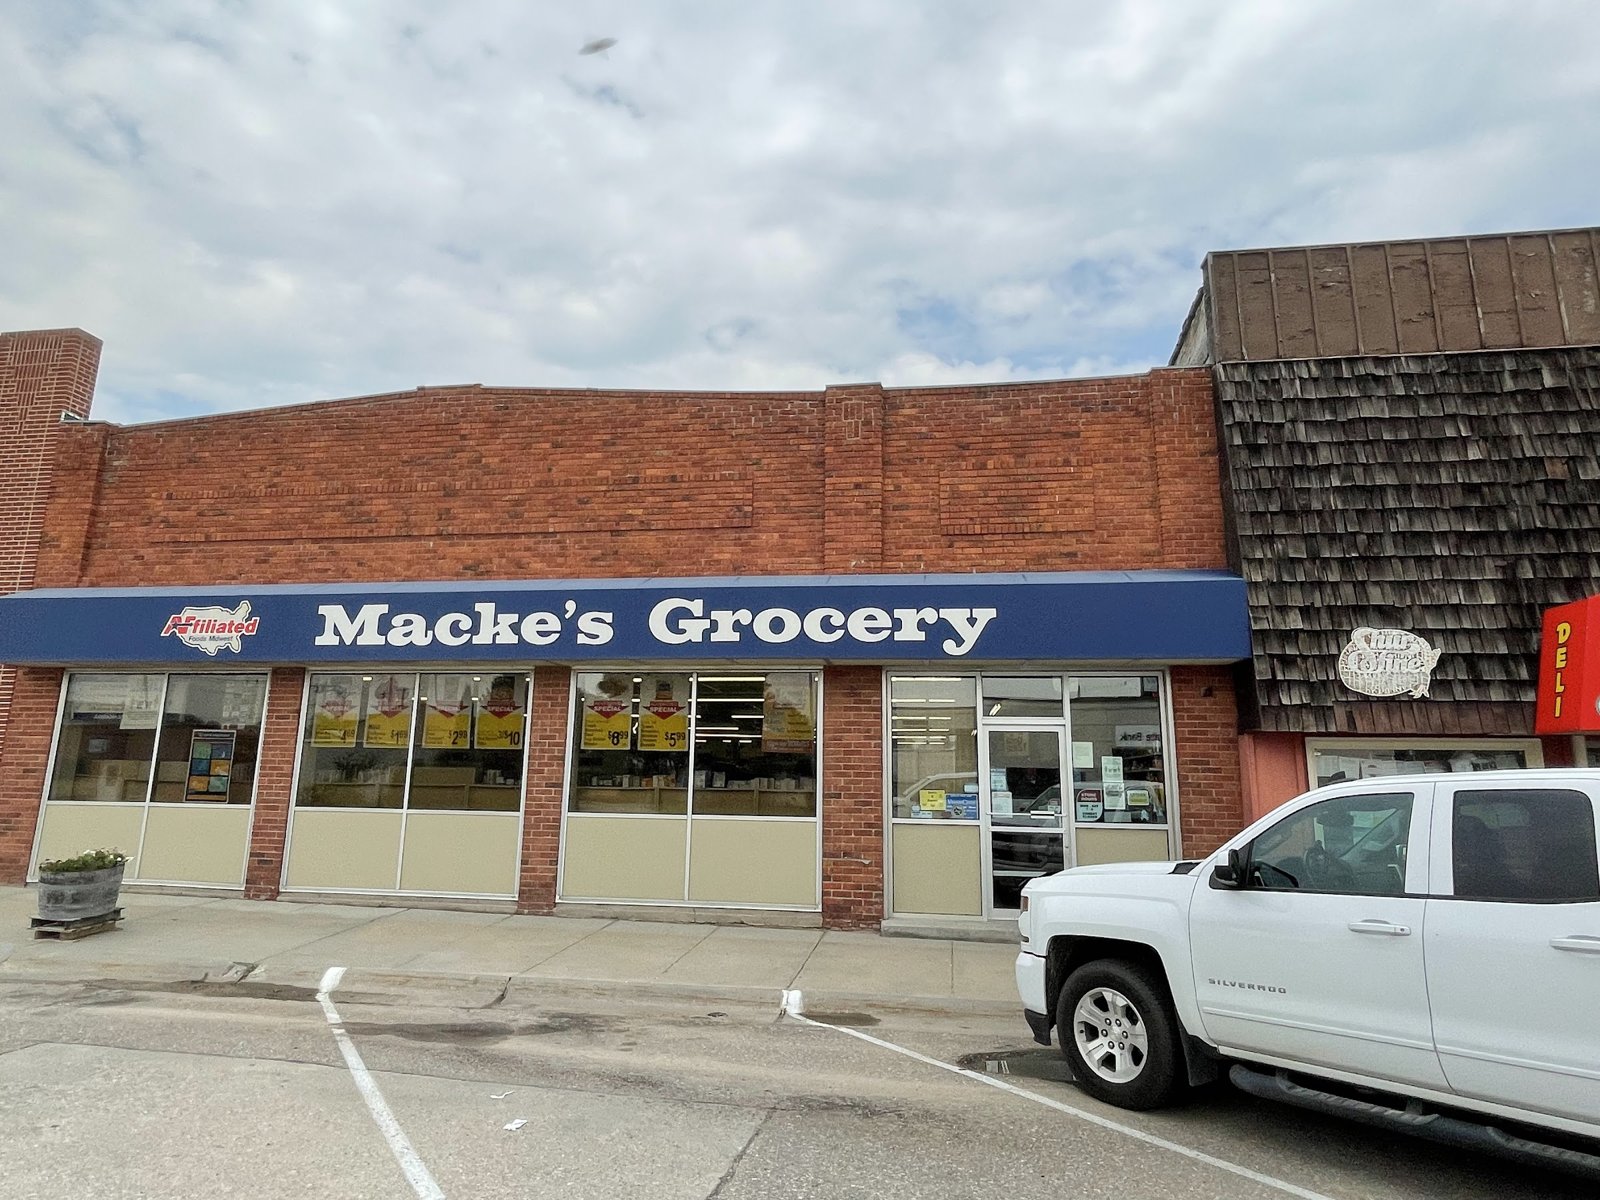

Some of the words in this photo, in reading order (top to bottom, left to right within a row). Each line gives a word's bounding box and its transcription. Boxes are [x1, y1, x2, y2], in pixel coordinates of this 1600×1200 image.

[314, 600, 614, 648] Macke's
[648, 597, 997, 656] Grocery
[1554, 622, 1571, 718] DELI
[1208, 978, 1287, 994] SILVERADO
